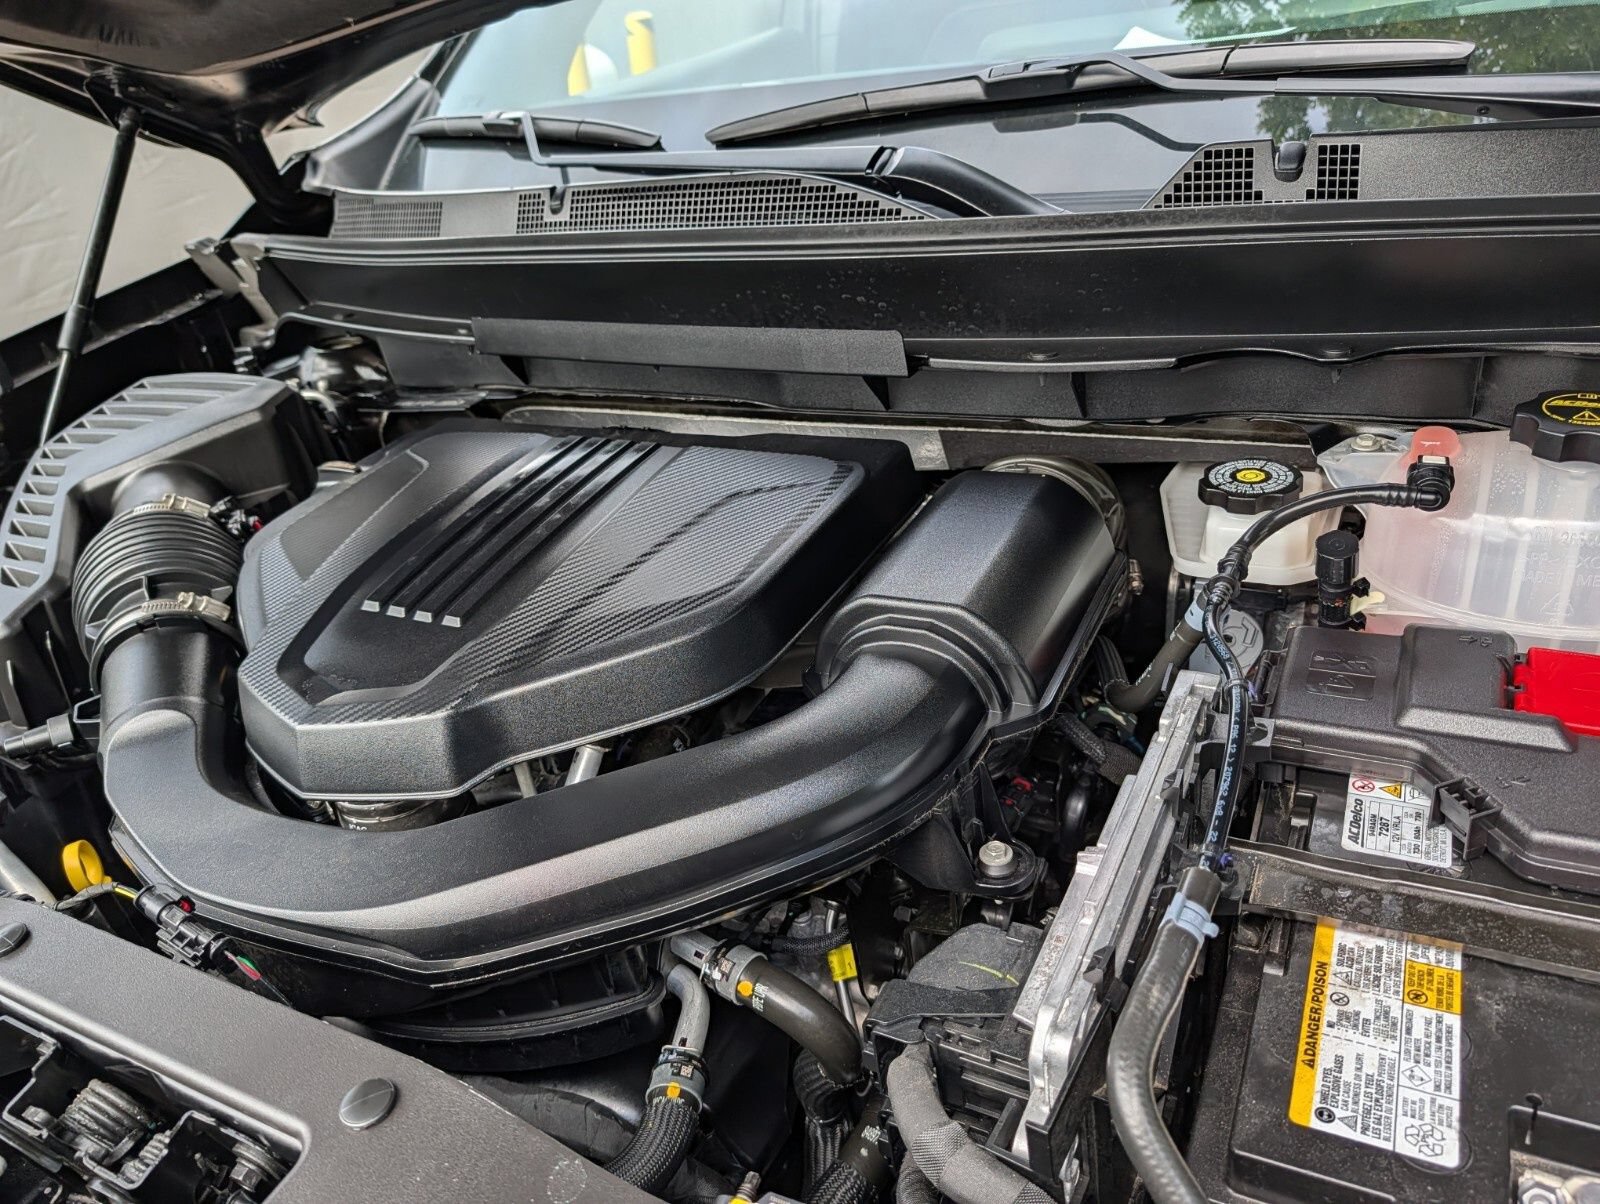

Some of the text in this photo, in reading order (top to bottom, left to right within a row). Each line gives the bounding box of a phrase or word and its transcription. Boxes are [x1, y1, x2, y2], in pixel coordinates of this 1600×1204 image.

[1348, 798, 1363, 843] ACDelco
[1369, 814, 1377, 836] 94RAGM
[1378, 817, 1389, 836] 7287
[1392, 832, 1400, 842] 12V
[1304, 961, 1328, 1057] DANGER/POISON
[1343, 1011, 1352, 1028] FLAMES
[1352, 1010, 1360, 1030] SMOKING
[1329, 1054, 1343, 1108] EXPLOSIVE GASES
[1319, 1084, 1330, 1105] SHIELD
[1340, 1080, 1351, 1111] CAN CAUSE
[1351, 1083, 1361, 1113] BLINDNESS
[1363, 1090, 1373, 1102] LES
[1371, 1053, 1386, 1139] LES GAZ EXPLOSIFS PEUVENT
[1385, 1083, 1394, 1105] RENDRE
[1382, 1115, 1392, 1142] BLESSER
